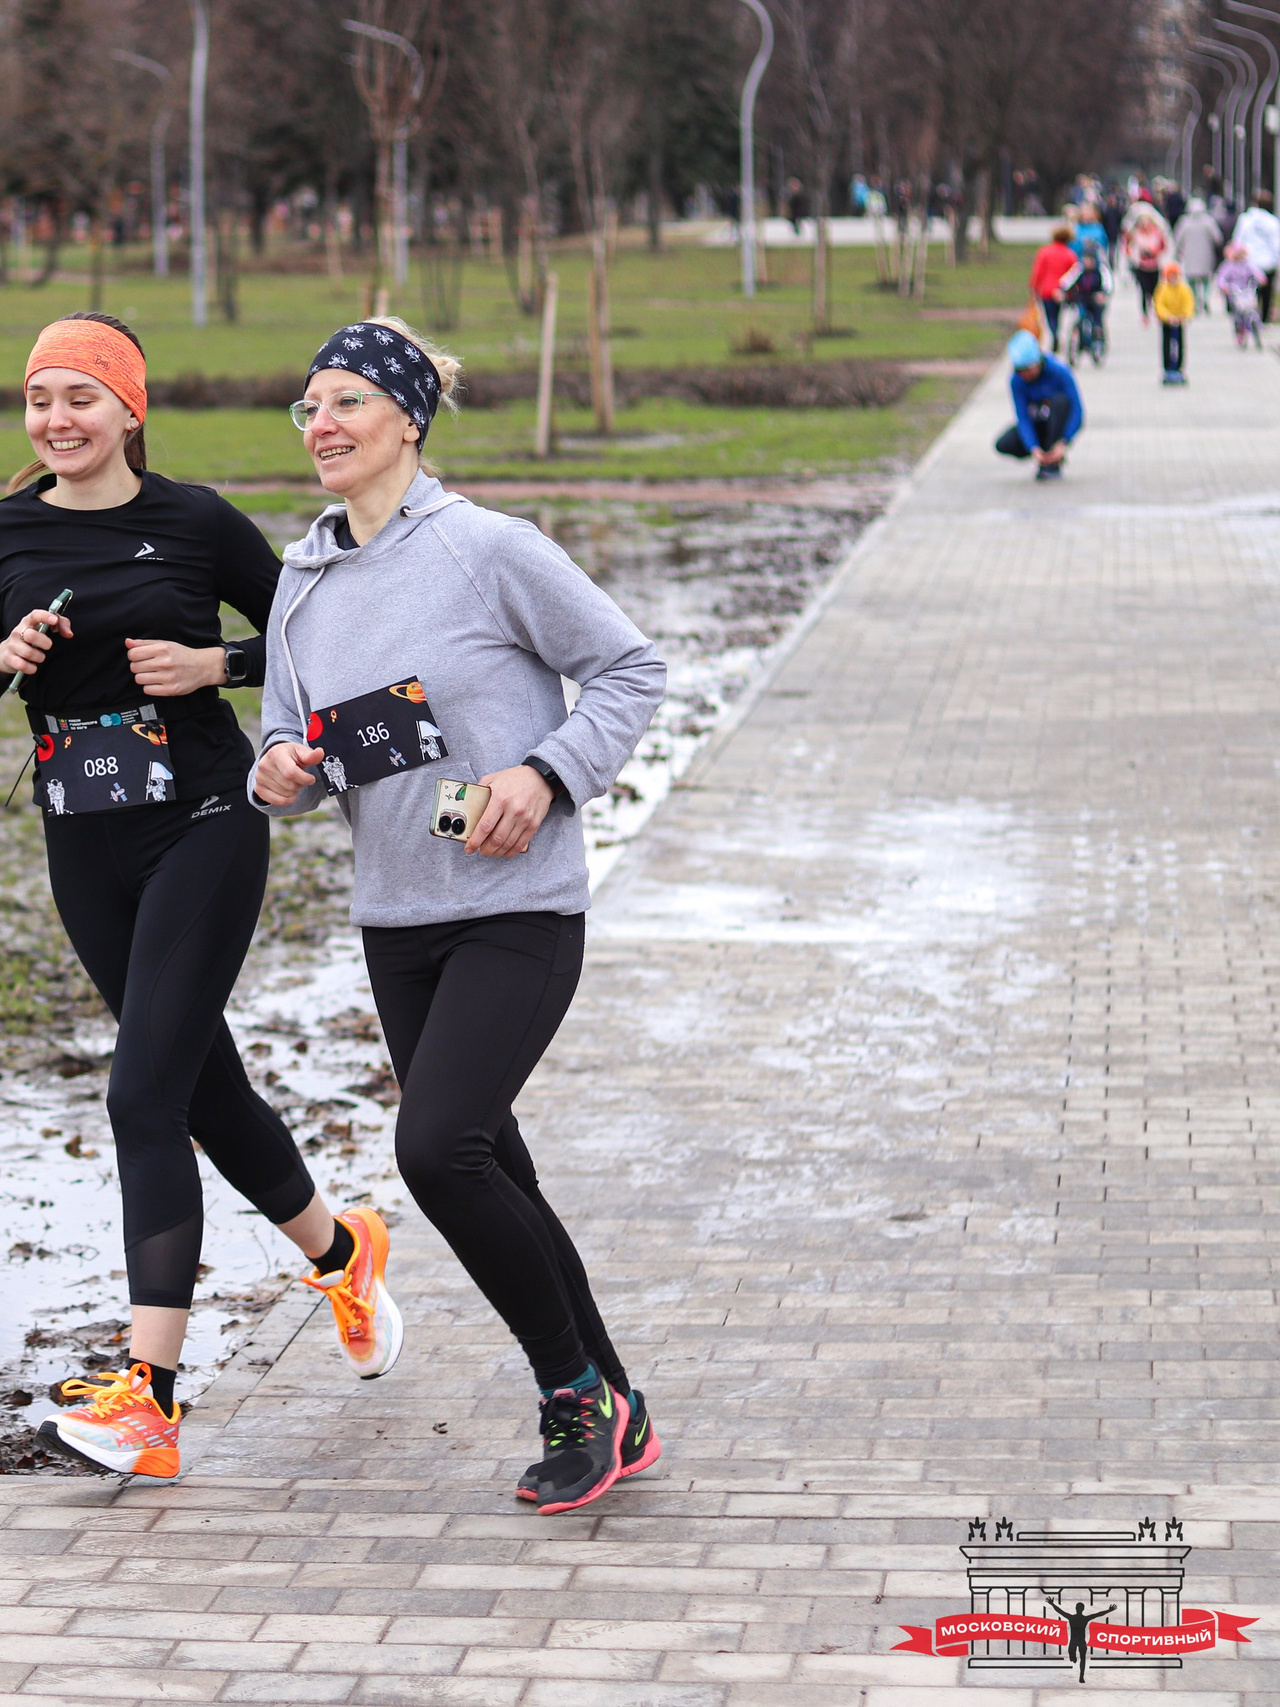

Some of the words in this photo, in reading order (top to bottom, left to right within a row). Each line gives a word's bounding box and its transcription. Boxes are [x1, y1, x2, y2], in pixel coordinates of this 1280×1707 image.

[356, 721, 391, 748] 186
[83, 755, 120, 778] 088
[190, 804, 232, 819] DEMIX
